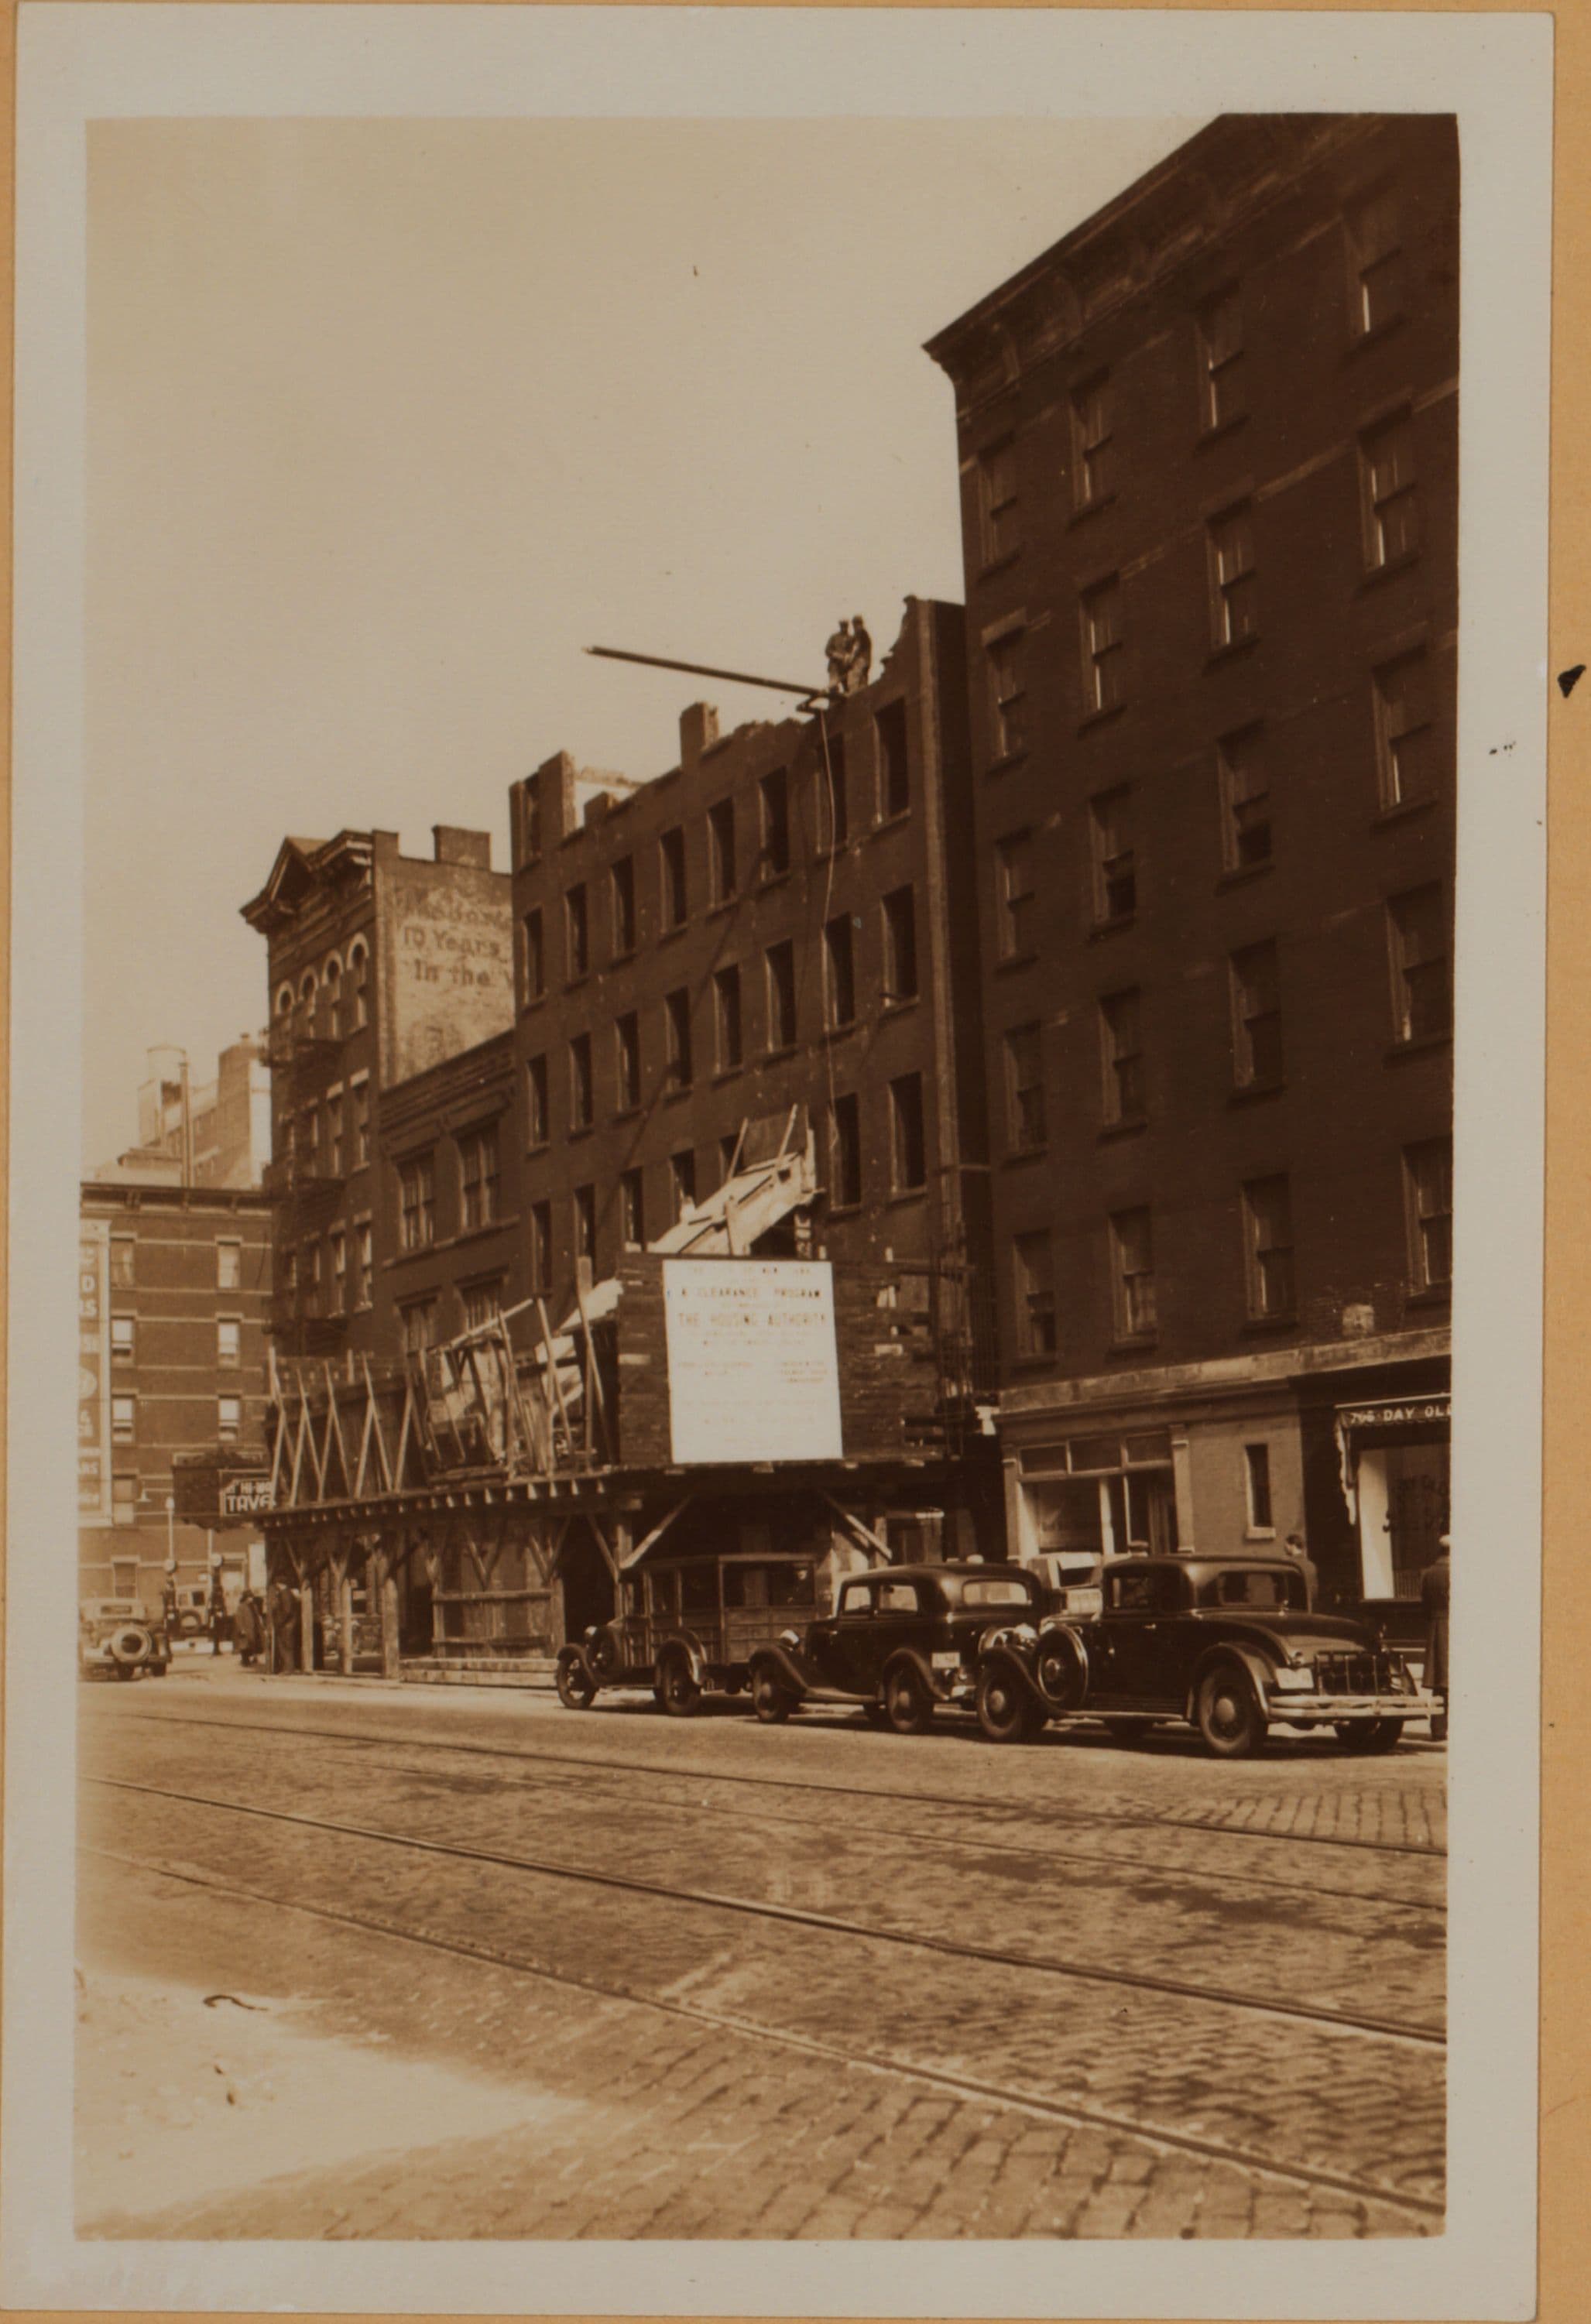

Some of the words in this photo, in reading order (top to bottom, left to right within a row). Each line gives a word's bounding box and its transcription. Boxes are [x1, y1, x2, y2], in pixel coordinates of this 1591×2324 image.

[433, 927, 500, 958] Years
[447, 963, 492, 986] the
[696, 1287, 760, 1298] CLEARANCE
[773, 1287, 821, 1298] PROGRAM
[678, 1312, 701, 1325] THE
[710, 1313, 758, 1326] HOUSING
[766, 1312, 827, 1326] AUTHORITY
[1383, 1407, 1415, 1421] DAY
